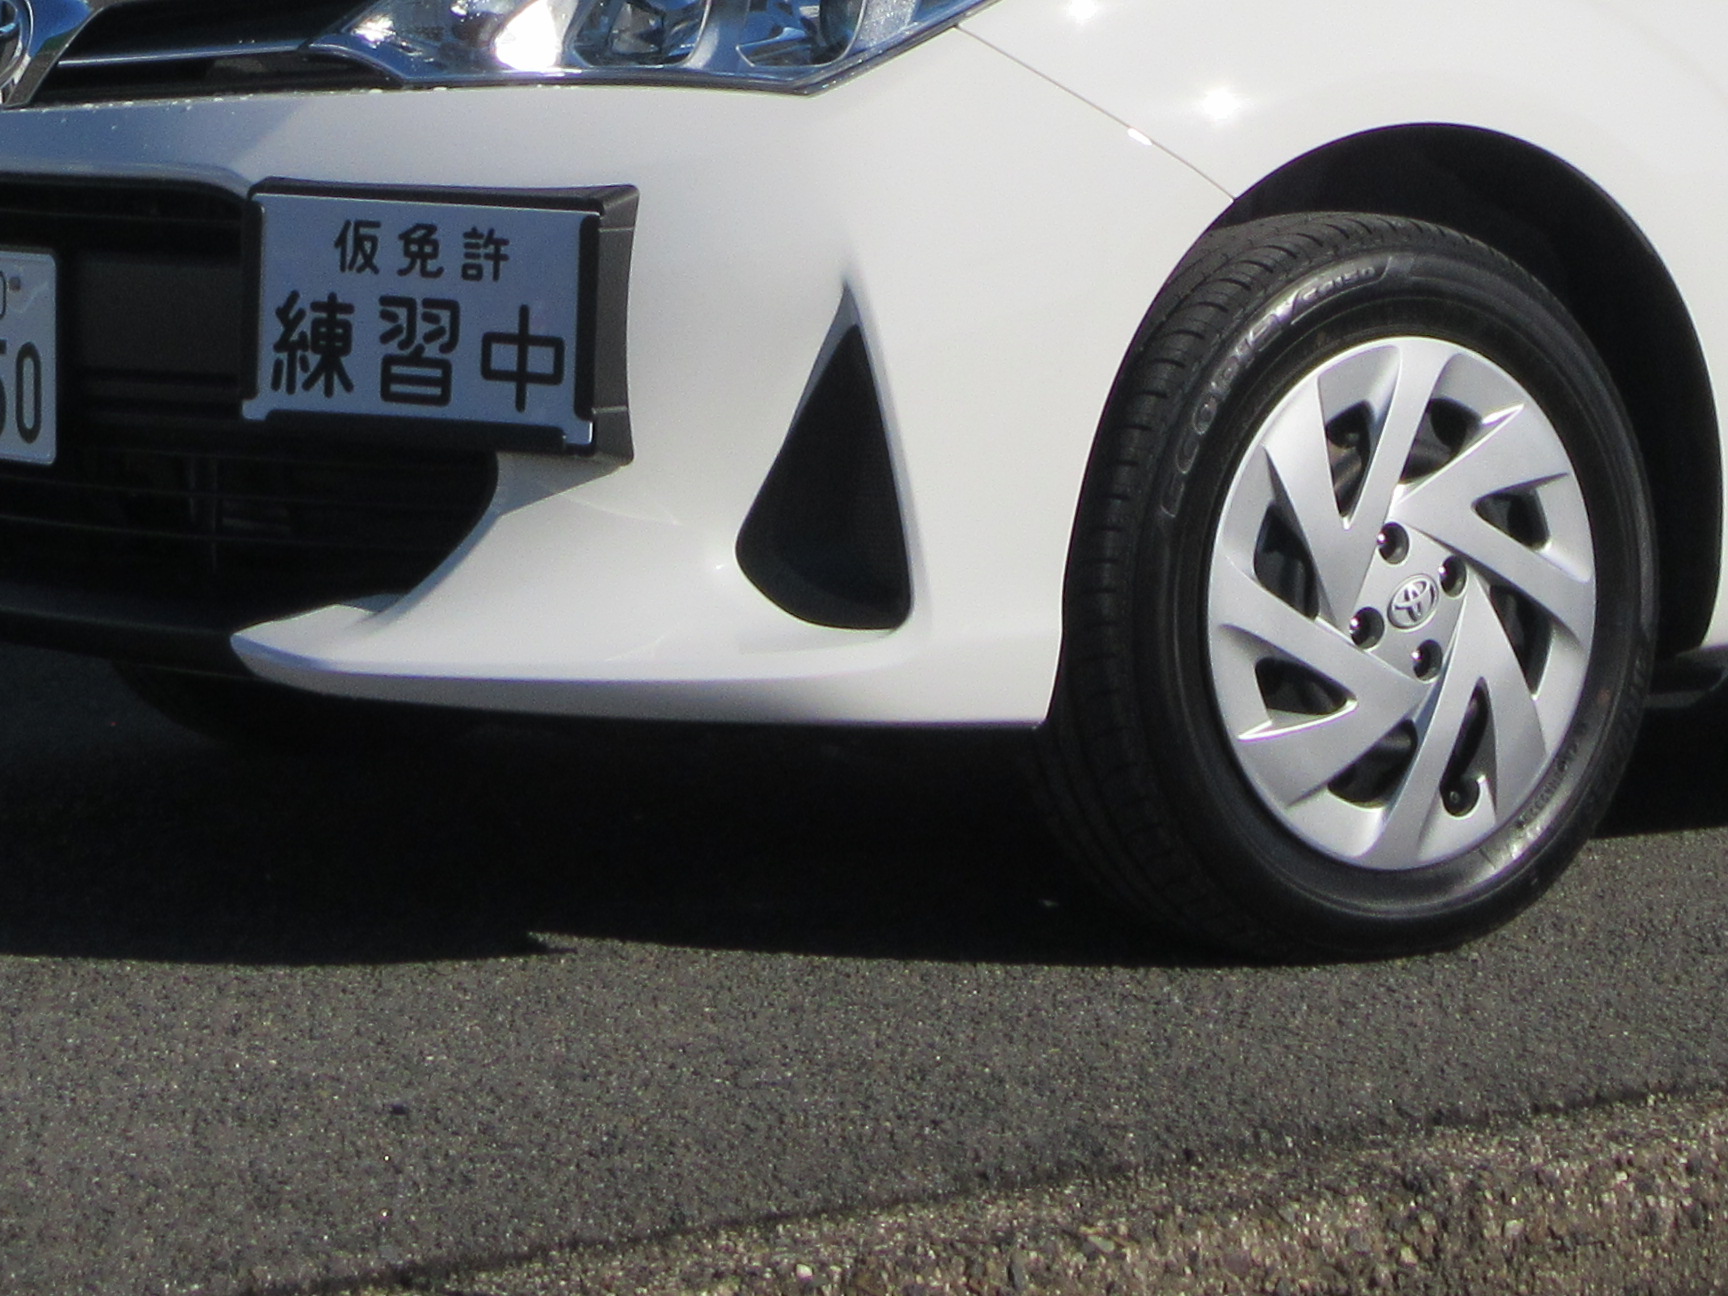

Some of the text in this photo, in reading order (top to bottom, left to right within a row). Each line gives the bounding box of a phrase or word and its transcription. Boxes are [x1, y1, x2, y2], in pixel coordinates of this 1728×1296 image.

[334, 218, 510, 283] 仮免許
[271, 289, 566, 414] 練習中
